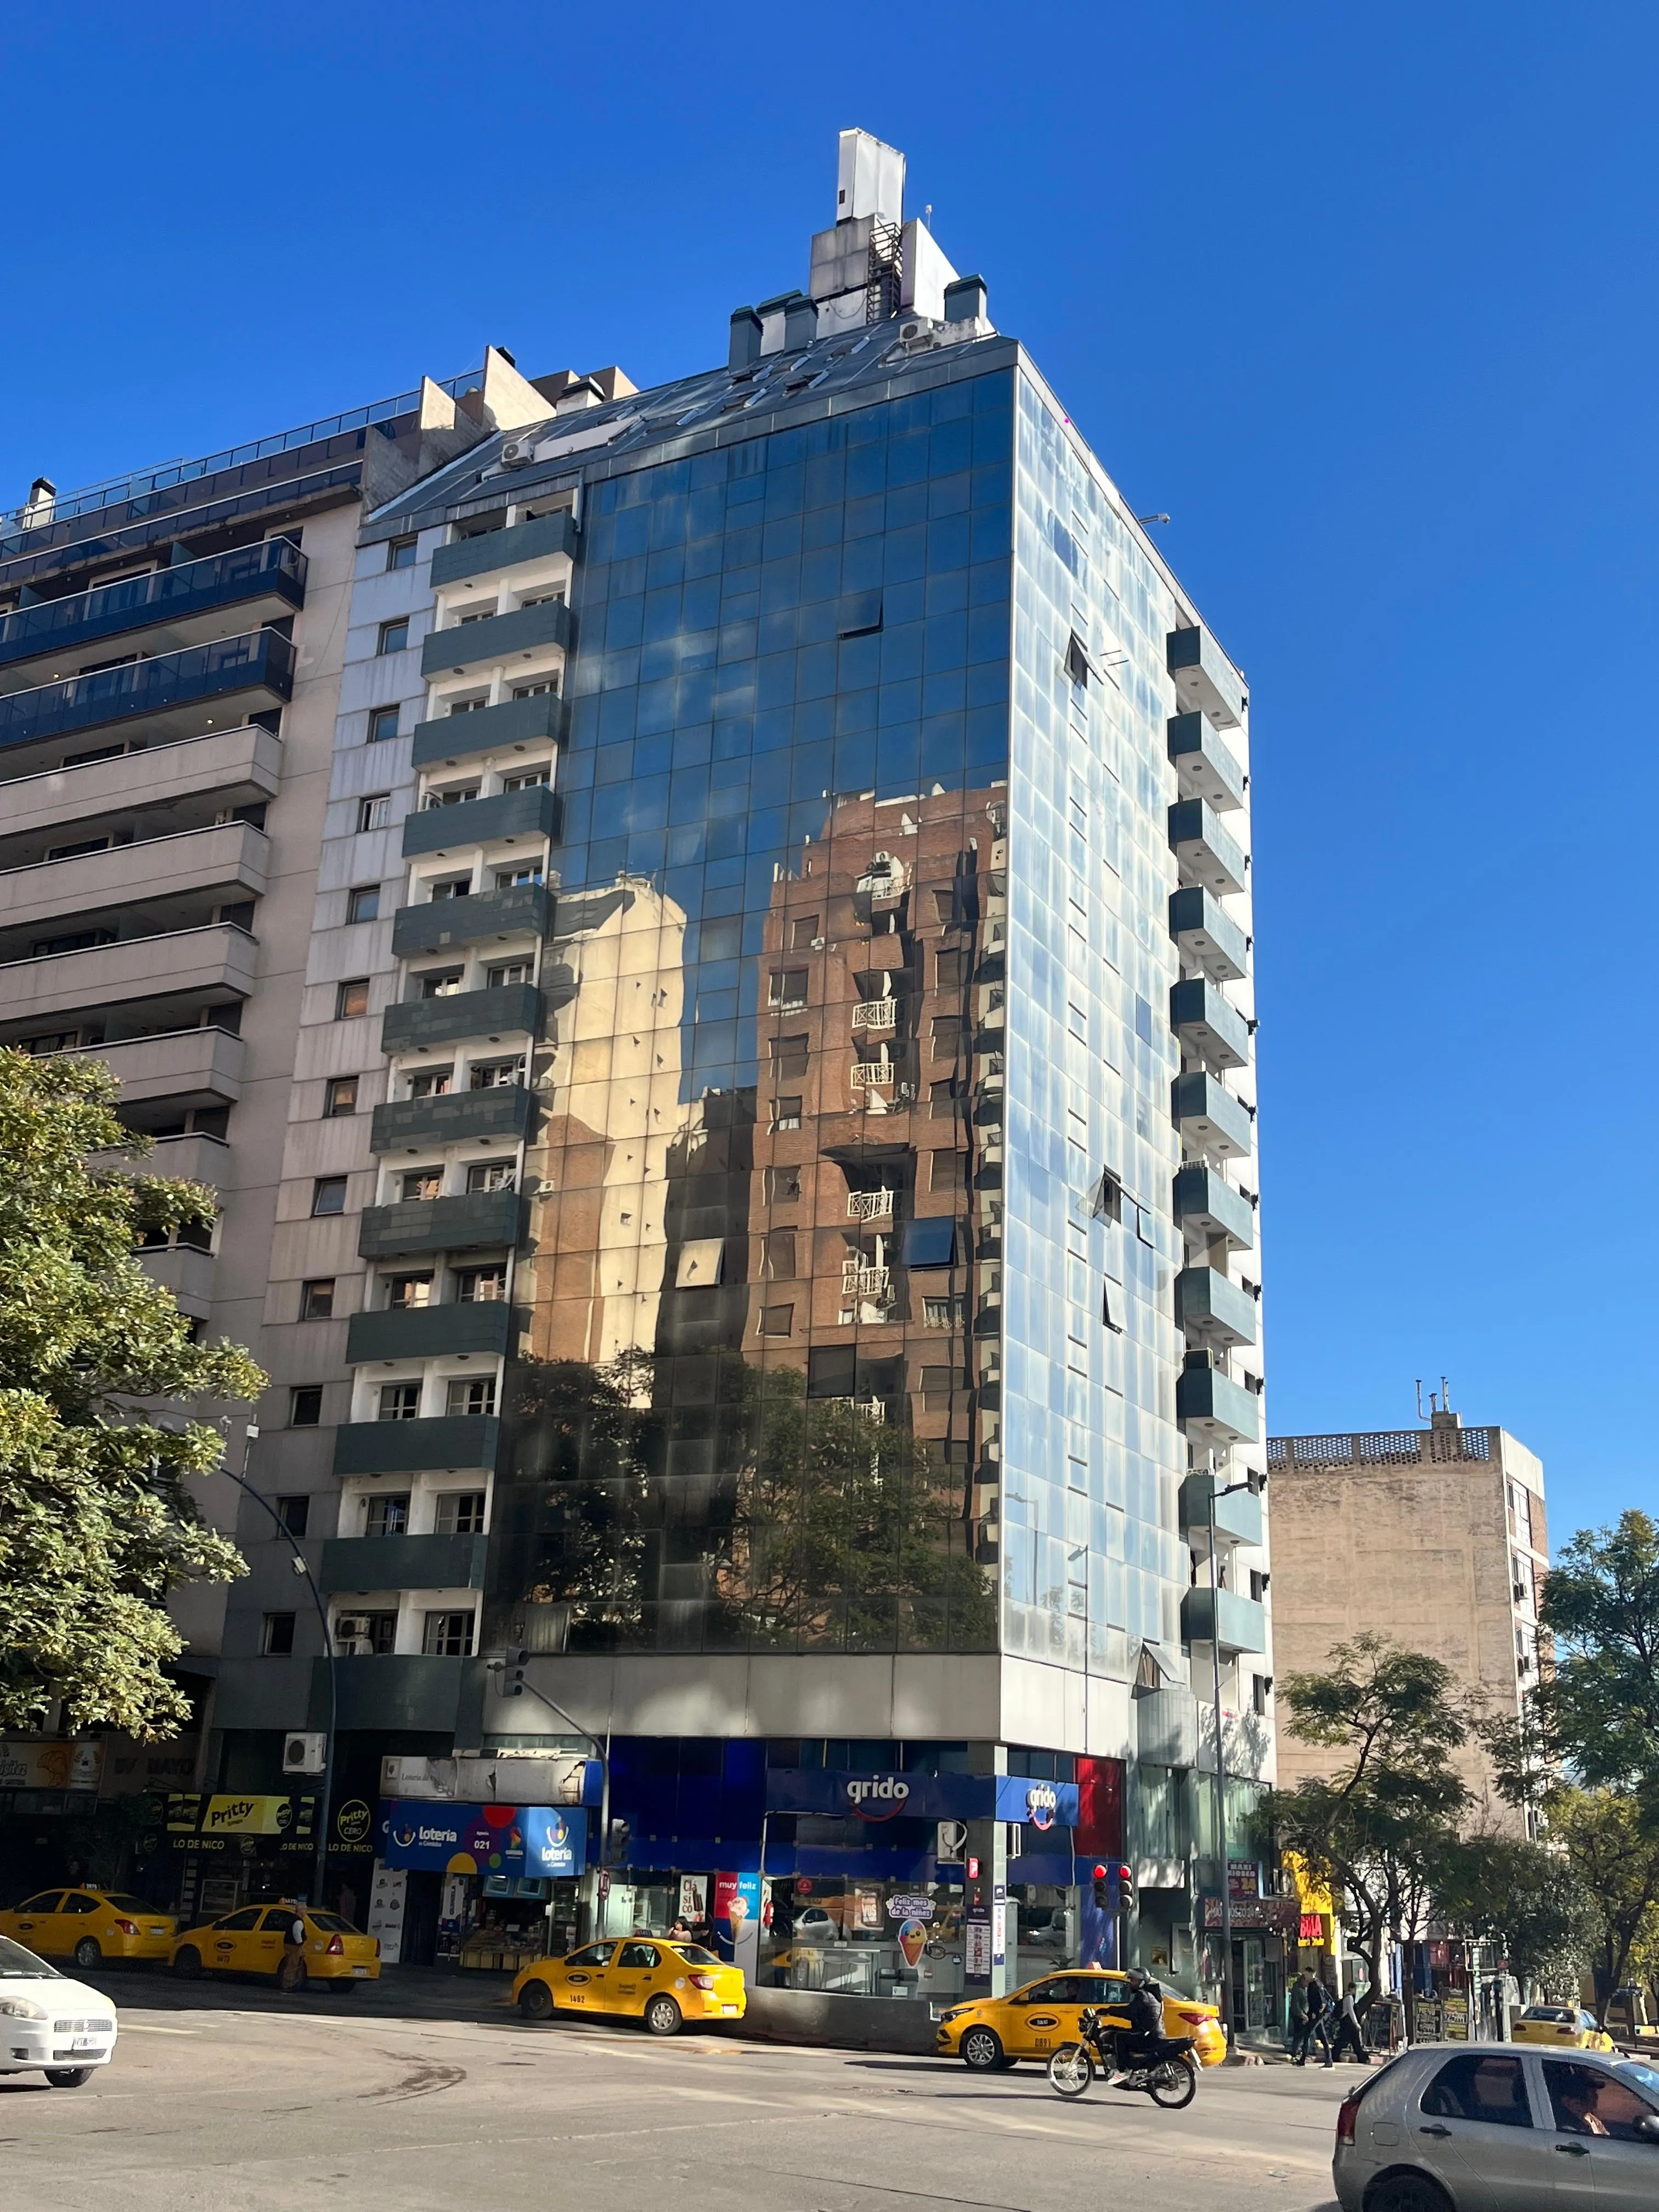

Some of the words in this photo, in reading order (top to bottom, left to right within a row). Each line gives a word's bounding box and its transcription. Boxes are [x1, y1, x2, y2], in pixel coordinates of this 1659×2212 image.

[847, 1775, 910, 1804] grido
[1028, 1783, 1056, 1810] grido
[211, 1801, 255, 1827] Pritty
[340, 1809, 369, 1826] Pritty
[343, 1827, 362, 1835] CERO
[173, 1839, 185, 1848] LO
[187, 1839, 200, 1849] DE
[201, 1840, 225, 1850] NICO
[298, 1843, 314, 1851] NICO
[328, 1843, 339, 1852] LO
[340, 1844, 352, 1852] DE
[353, 1844, 373, 1853] NICO
[474, 1840, 490, 1849] 021
[719, 1882, 737, 1890] muy
[739, 1881, 757, 1889] feliz
[891, 1907, 900, 1915] de
[902, 1908, 909, 1916] la
